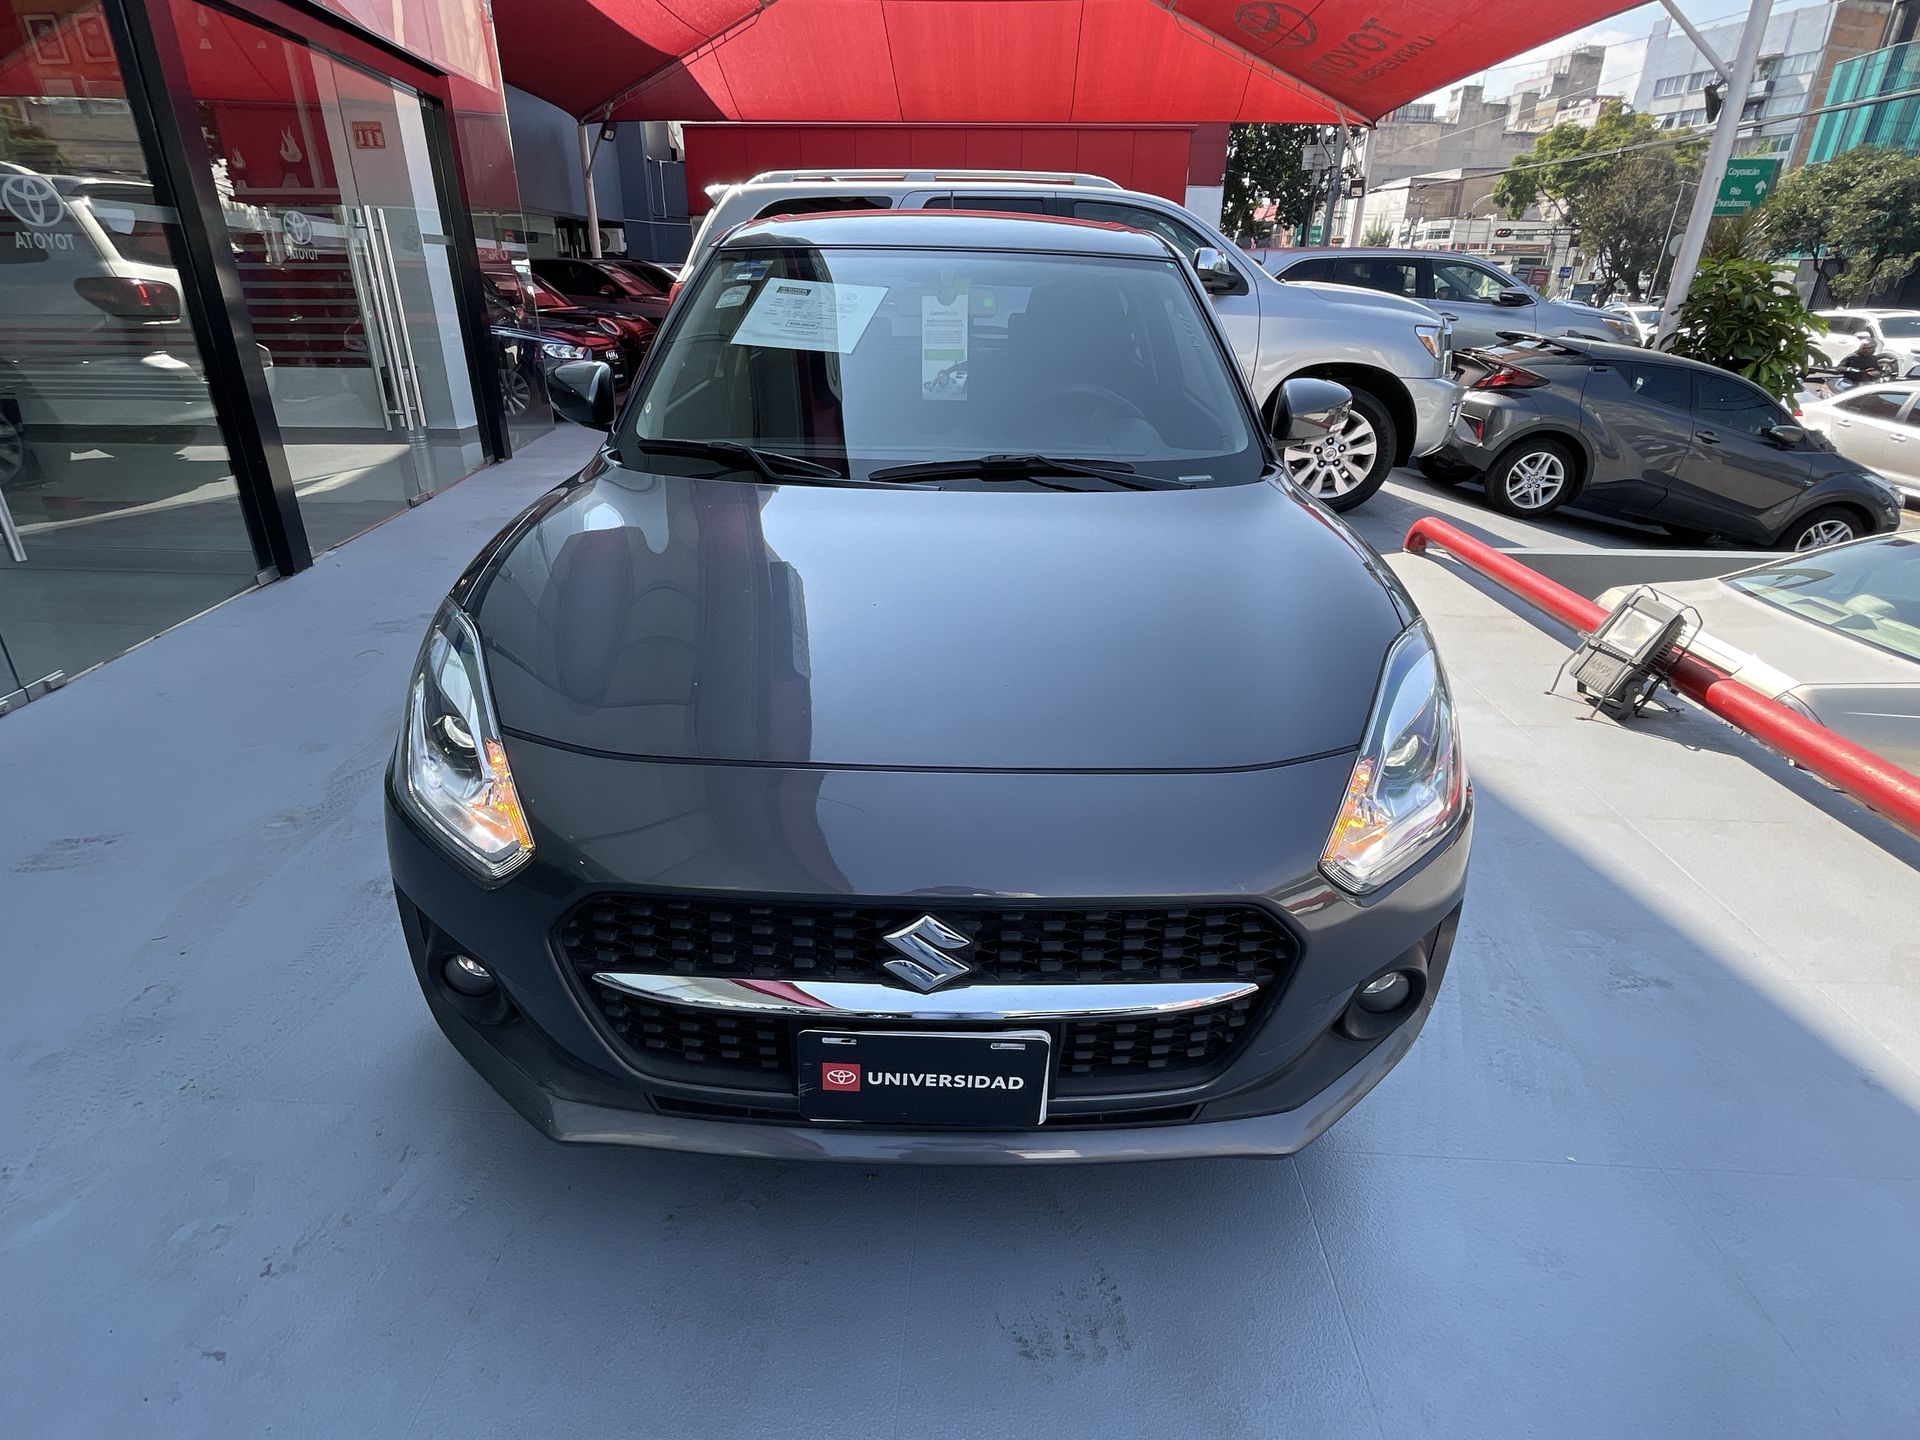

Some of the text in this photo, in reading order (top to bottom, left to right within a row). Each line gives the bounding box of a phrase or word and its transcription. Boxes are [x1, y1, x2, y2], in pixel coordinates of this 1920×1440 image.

[1728, 167, 1760, 177] Coyoacán
[1716, 199, 1751, 207] hurubusco
[867, 1071, 1025, 1090] UNIVERSIDAD
